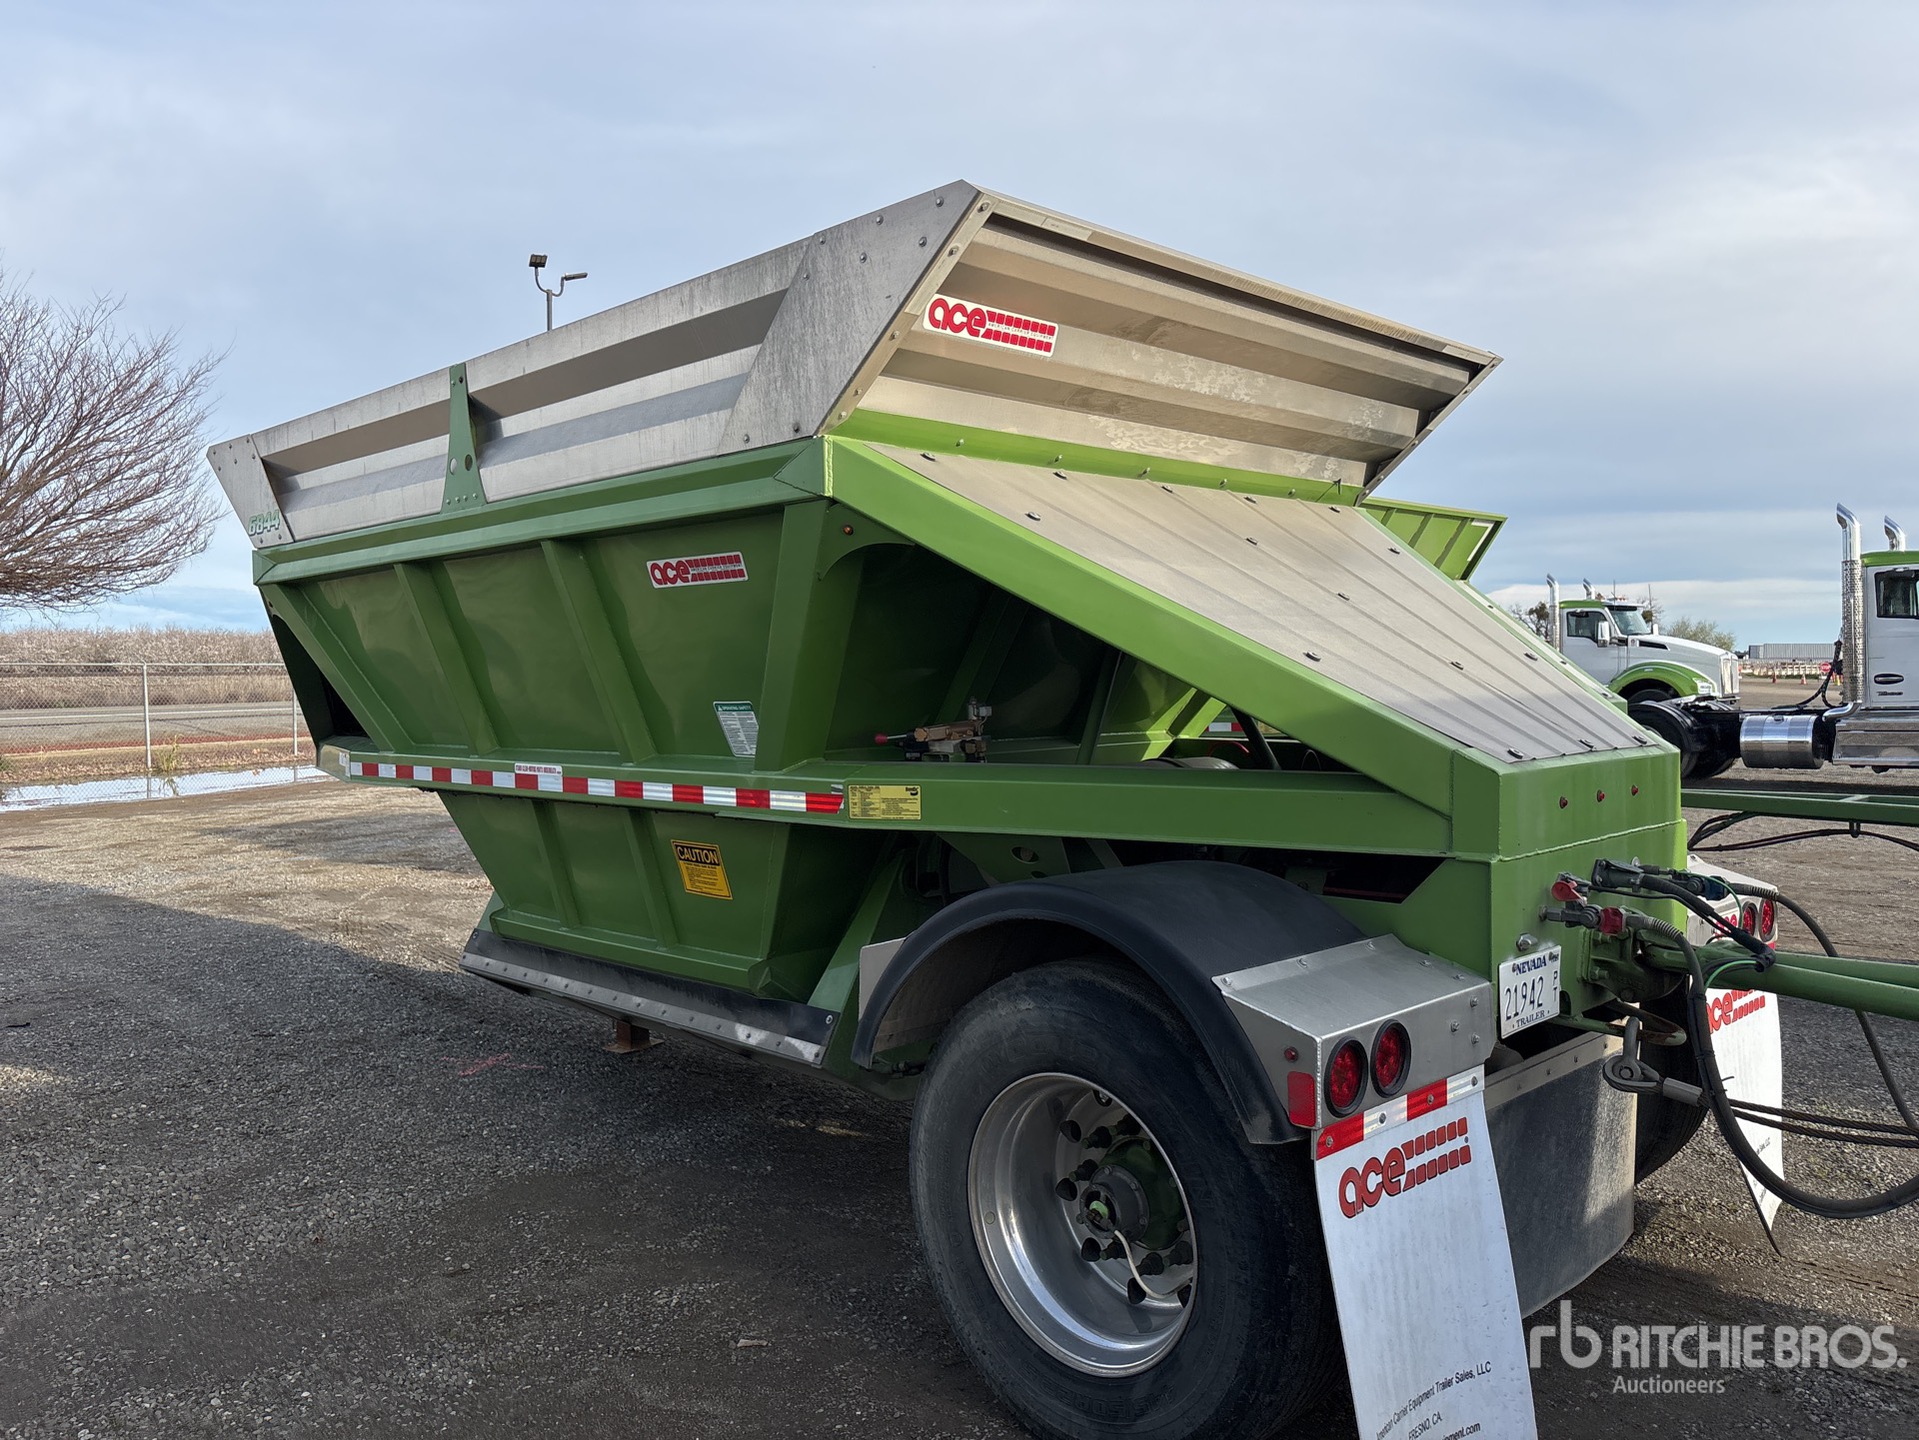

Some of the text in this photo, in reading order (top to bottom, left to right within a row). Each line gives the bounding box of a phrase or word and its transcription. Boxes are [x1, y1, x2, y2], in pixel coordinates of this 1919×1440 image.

[928, 297, 987, 338] ace
[650, 560, 691, 585] ace
[676, 846, 719, 864] CAUTION
[1515, 954, 1547, 976] NEVADA
[1504, 975, 1544, 1021] 21942
[1516, 1009, 1546, 1028] TRAILER
[1338, 1147, 1405, 1219] ace
[1393, 1405, 1409, 1424] Carrier
[1408, 1386, 1435, 1411] Equipment
[1435, 1376, 1454, 1393] Trailer
[1454, 1370, 1476, 1383] Sales,
[1476, 1361, 1492, 1376] LLC
[1431, 1411, 1443, 1425] CA
